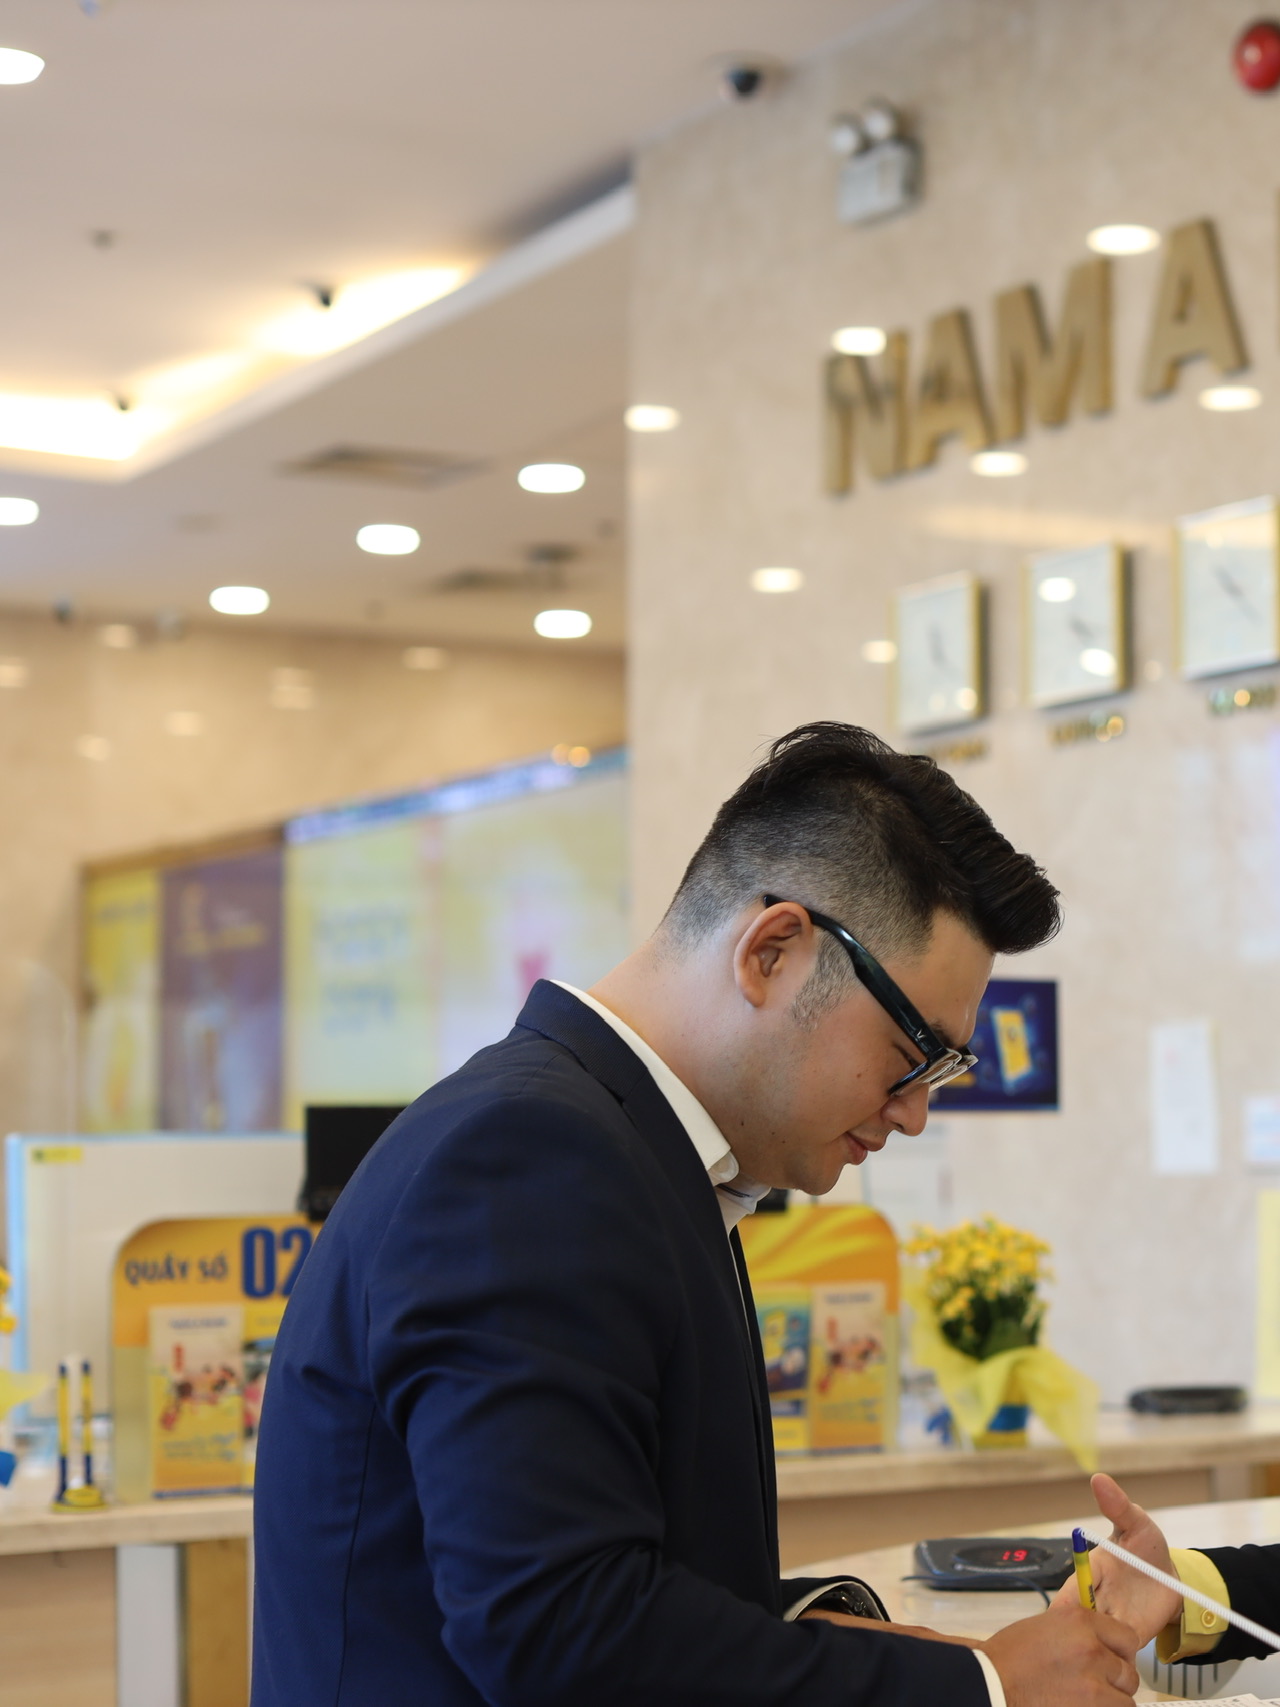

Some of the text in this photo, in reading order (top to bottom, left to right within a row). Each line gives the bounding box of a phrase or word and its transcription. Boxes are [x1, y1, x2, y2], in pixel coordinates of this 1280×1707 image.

[823, 259, 1114, 497] NAM
[1139, 217, 1252, 402] A
[242, 1226, 313, 1299] 02
[1002, 1549, 1028, 1562] 19
